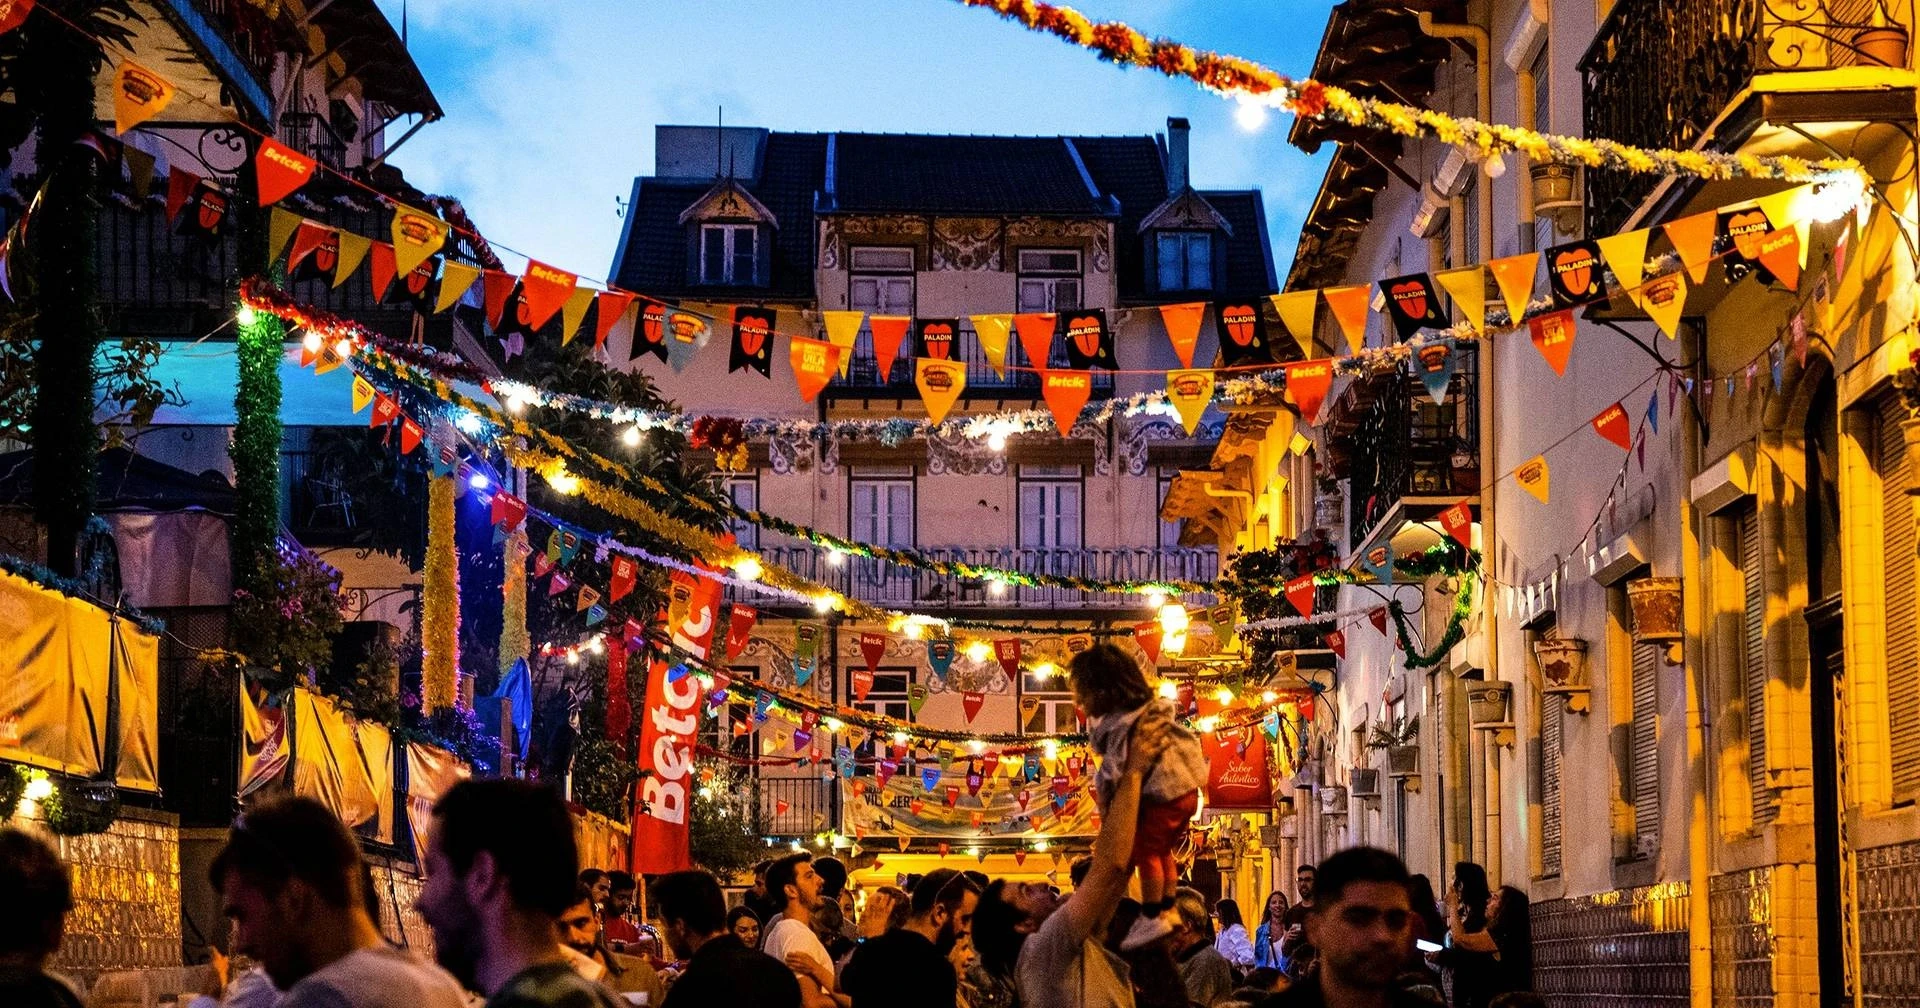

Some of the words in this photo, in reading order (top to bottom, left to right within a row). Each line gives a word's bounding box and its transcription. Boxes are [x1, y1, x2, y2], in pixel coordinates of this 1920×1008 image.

[265, 147, 307, 174] Betclic
[200, 198, 225, 214] PALADIN
[1729, 222, 1768, 236] PALADIN
[1762, 234, 1795, 255] Betclic
[1557, 259, 1594, 274] PALADIN
[531, 265, 573, 287] Betclic
[1394, 289, 1427, 300] PALADIN
[1224, 316, 1256, 324] PALADIN
[740, 325, 768, 335] PALADIN
[1070, 326, 1101, 336] PALADIN
[1291, 366, 1327, 379] Betclic
[1048, 376, 1085, 388] Betclic
[1597, 408, 1622, 428] Betclic
[1288, 580, 1311, 593] Betclic
[734, 607, 753, 618] Betclic
[863, 636, 882, 646] Betclic
[1227, 760, 1254, 773] Sabor
